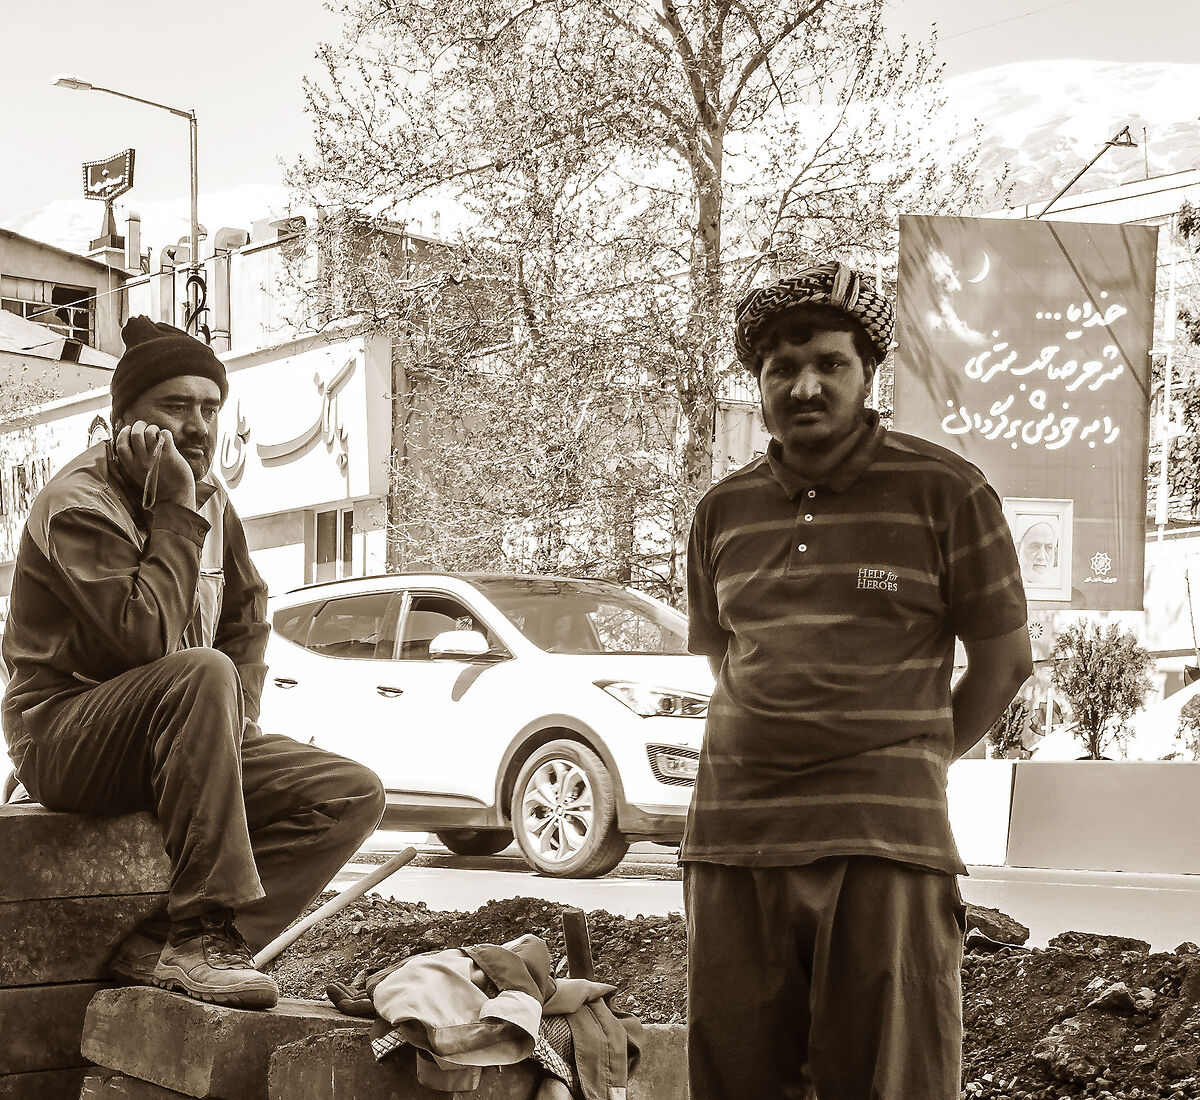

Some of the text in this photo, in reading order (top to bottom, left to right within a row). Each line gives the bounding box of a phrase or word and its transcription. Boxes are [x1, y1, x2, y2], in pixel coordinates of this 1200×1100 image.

[1010, 346, 1078, 391] صاحب
[1065, 361, 1103, 392] هر
[941, 390, 1120, 450] را به خودش برگردان
[856, 579, 898, 592] HEROES
[857, 568, 898, 582] HELP for
